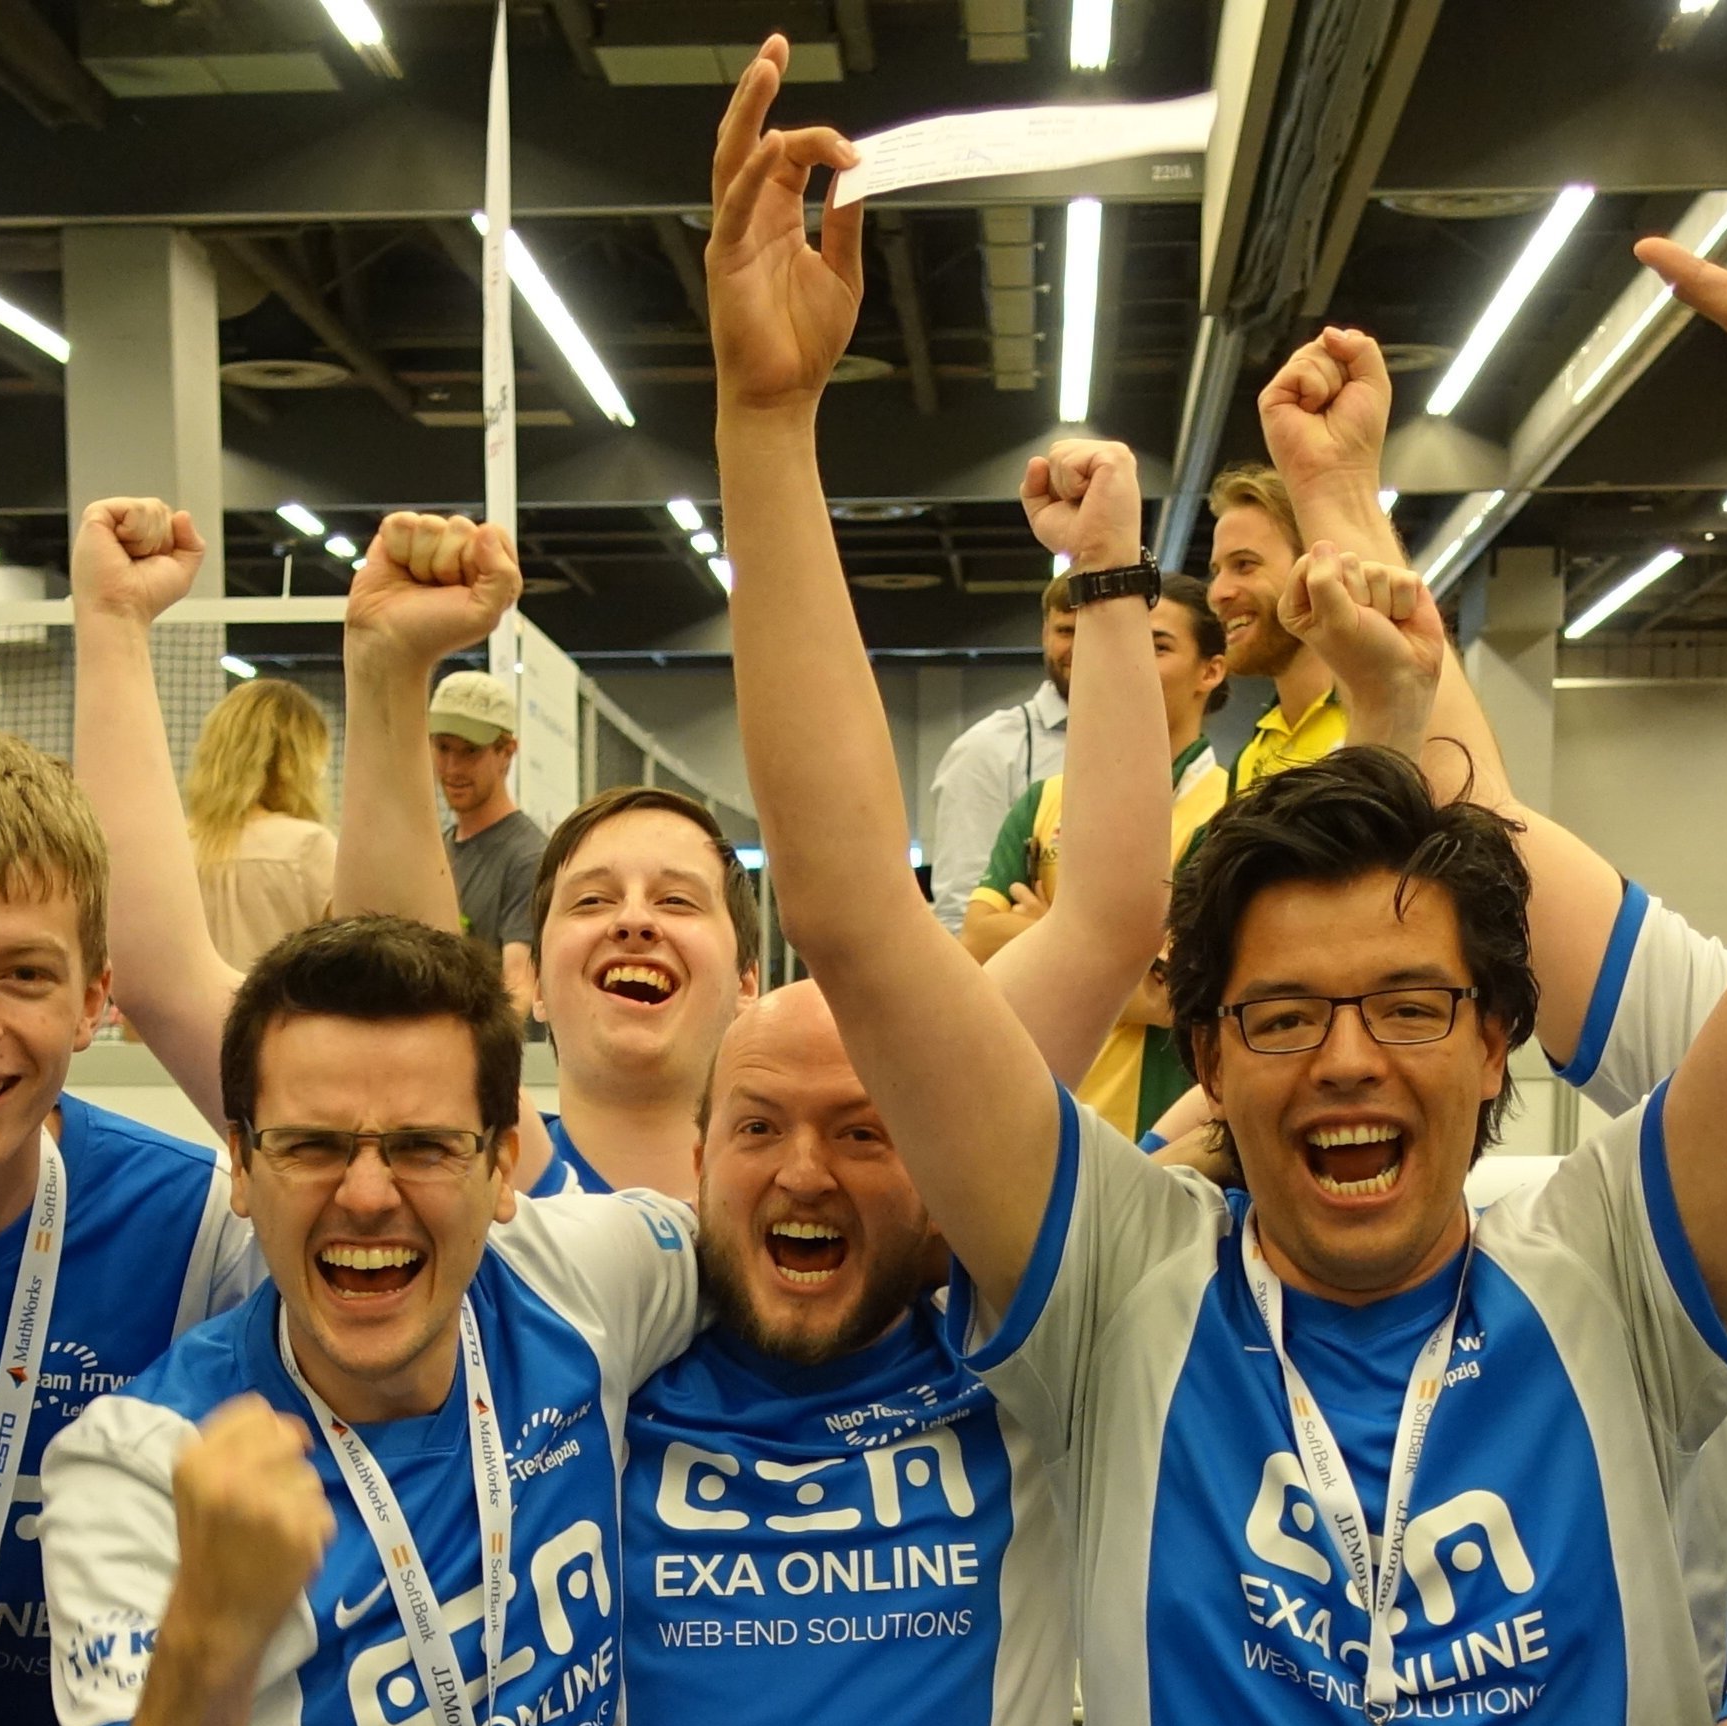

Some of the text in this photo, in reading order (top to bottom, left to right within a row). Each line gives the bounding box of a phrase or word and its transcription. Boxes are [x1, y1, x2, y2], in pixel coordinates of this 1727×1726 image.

[39, 1155, 57, 1230] SoftBank
[13, 1275, 43, 1361] MathWorks
[78, 1372, 134, 1393] HTW
[479, 1420, 499, 1507] MathWorks
[539, 1438, 581, 1474] Leipzig
[1301, 1421, 1337, 1491] SoftBank
[1405, 1403, 1432, 1474] SoftBank
[341, 1439, 390, 1523] MathWorks
[400, 1570, 437, 1644] SoftBank
[491, 1559, 503, 1634] SoftBank
[655, 1544, 979, 1597] EXA ONLINE
[658, 1609, 973, 1648] WEB-END SOLUTIONS
[1240, 1573, 1332, 1660] EXA
